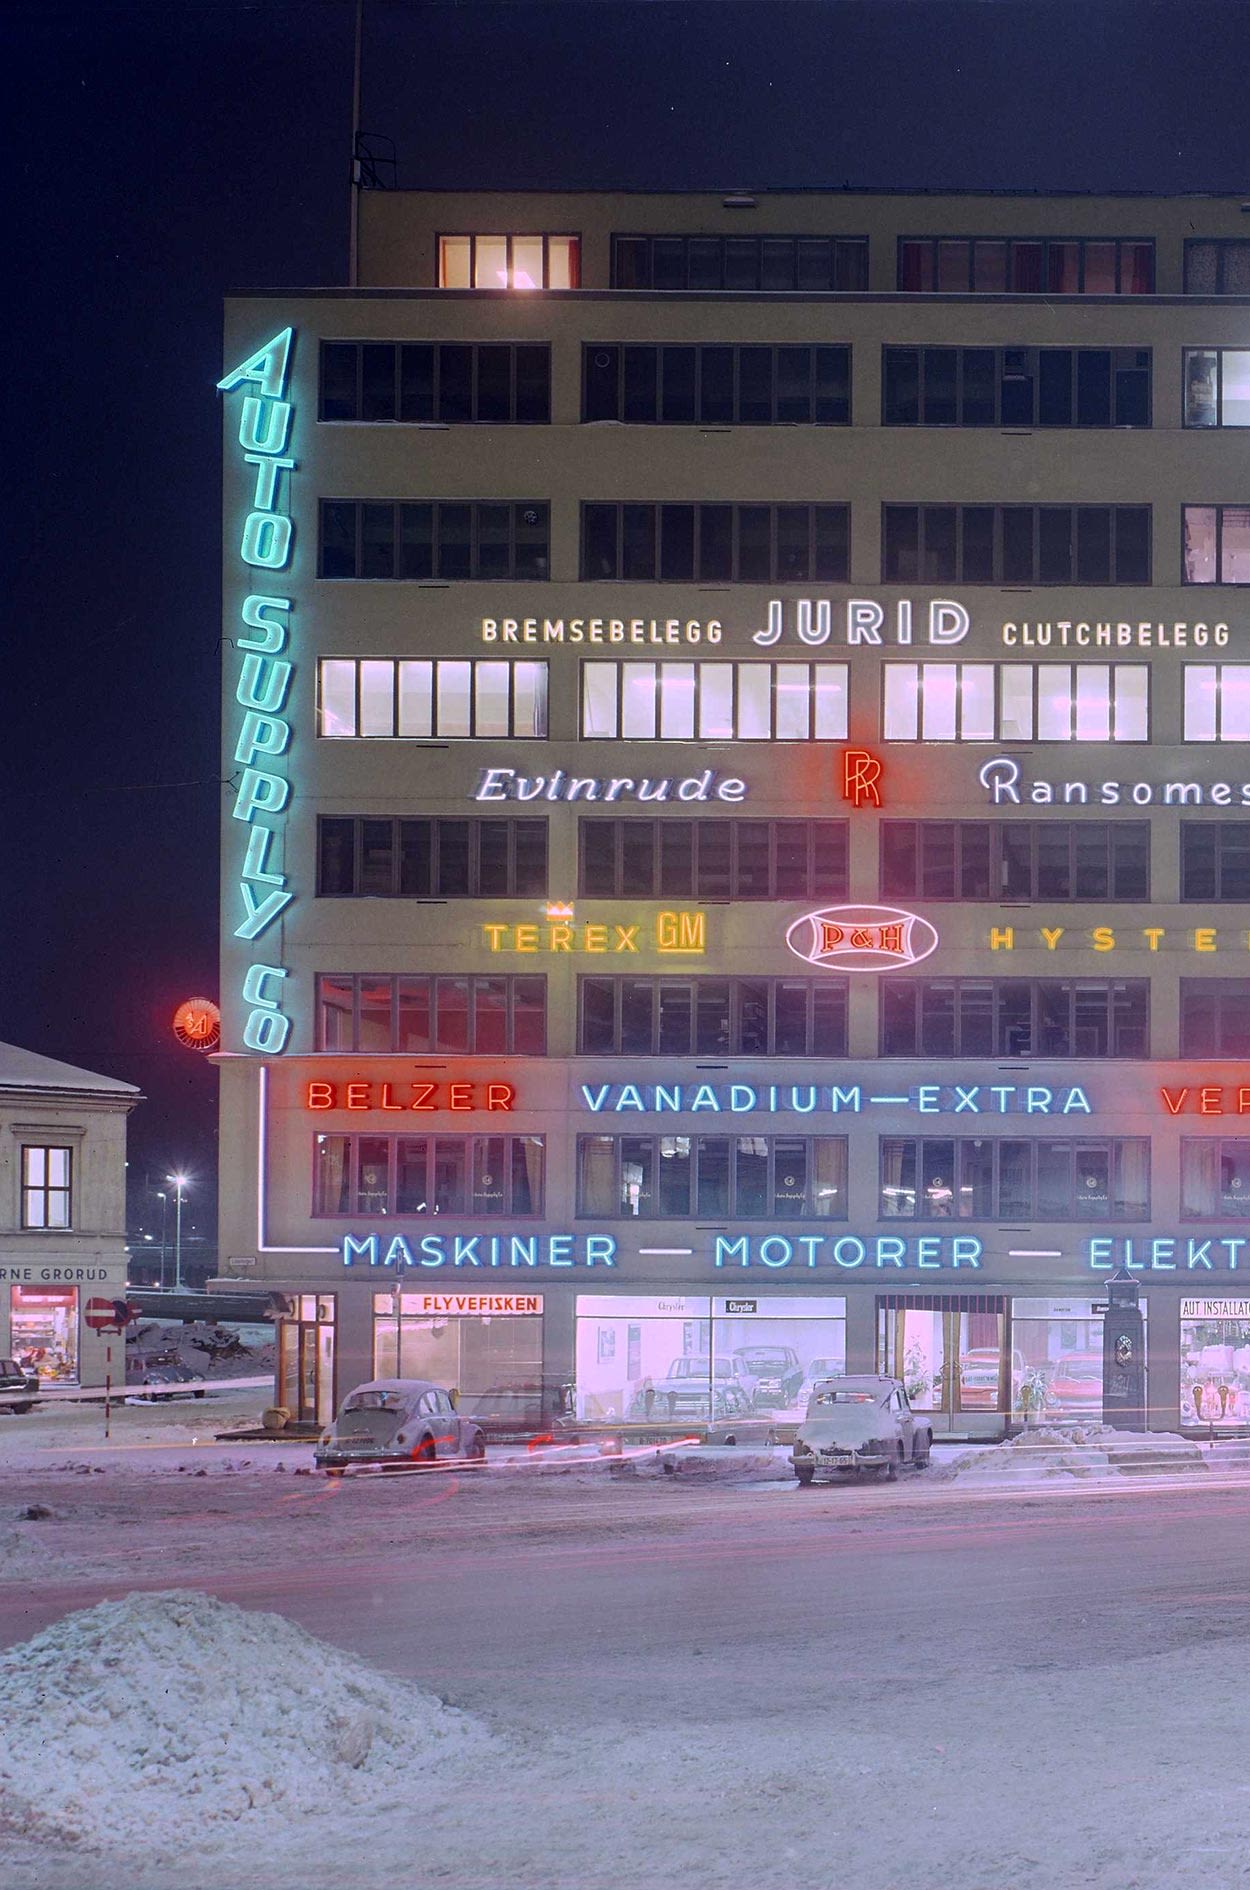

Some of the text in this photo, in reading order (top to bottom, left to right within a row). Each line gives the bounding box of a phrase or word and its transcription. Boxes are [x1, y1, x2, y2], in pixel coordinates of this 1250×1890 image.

[482, 617, 723, 644] BREMSEBELEGG
[752, 599, 970, 646] JURID
[1002, 621, 1230, 646] CLUTCHBELEGG
[216, 326, 295, 1054] AUTO SUPPLY CO
[474, 768, 747, 803] Evinrude
[483, 923, 641, 953] TEREX
[656, 910, 705, 949] GM
[821, 921, 905, 954] P&H
[306, 1081, 516, 1111] BELZER
[342, 1235, 618, 1268] MASKINER
[714, 1236, 983, 1269] MOTORER
[41, 1268, 108, 1280] GRORUD
[423, 1295, 537, 1311] FLYVEFISKEN
